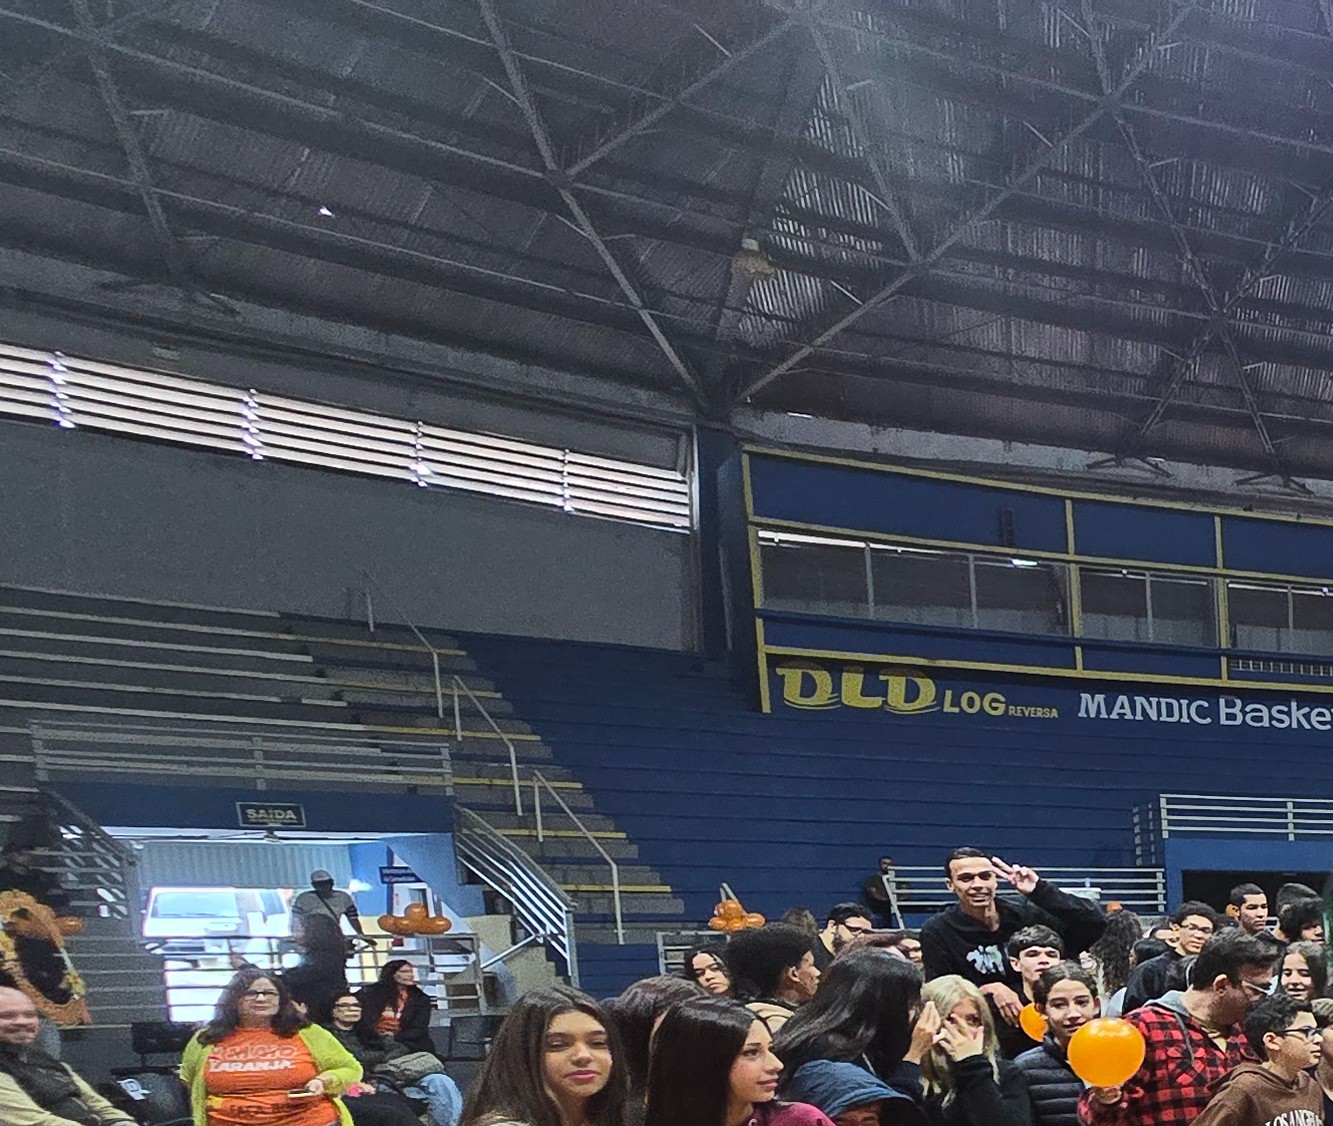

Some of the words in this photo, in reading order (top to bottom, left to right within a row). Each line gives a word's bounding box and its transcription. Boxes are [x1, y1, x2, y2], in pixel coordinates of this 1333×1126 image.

[943, 690, 1005, 716] LOG
[1008, 705, 1059, 719] REVERSA
[1077, 693, 1212, 725] MANDIC
